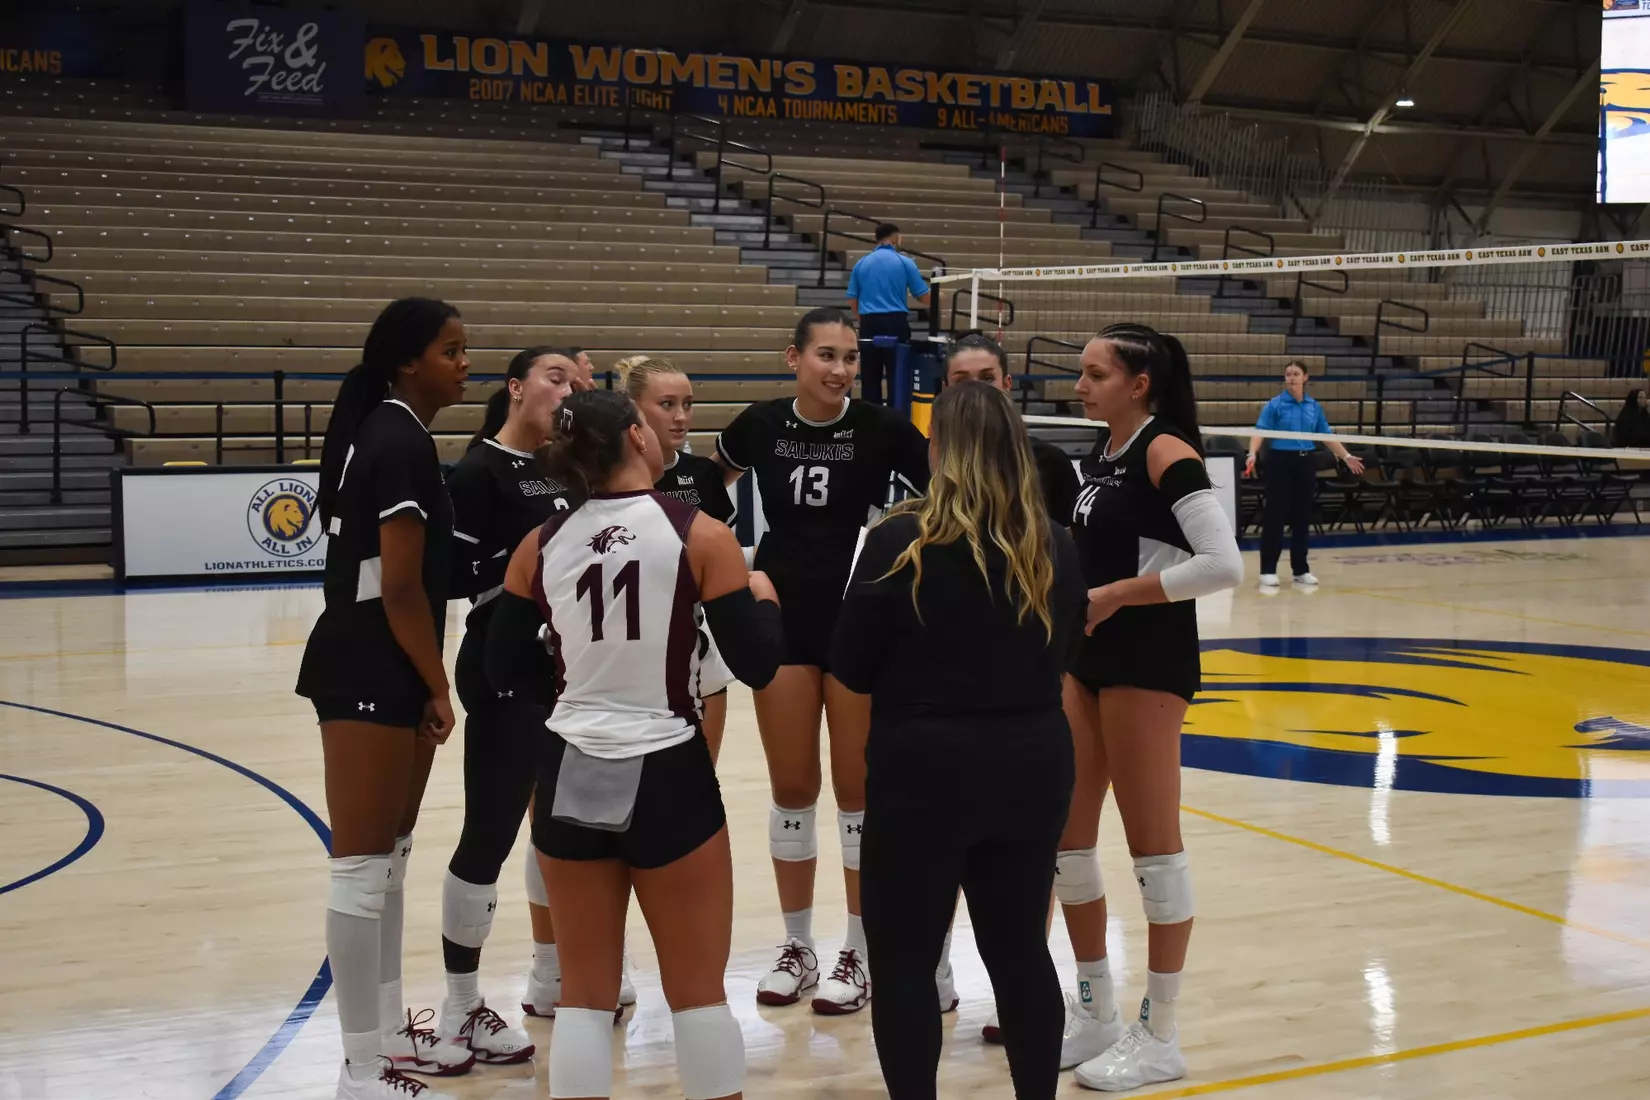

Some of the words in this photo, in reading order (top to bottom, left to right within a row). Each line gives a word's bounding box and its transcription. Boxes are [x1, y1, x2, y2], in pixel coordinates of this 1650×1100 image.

[226, 18, 284, 60] Fix
[284, 21, 319, 69] &
[0, 48, 62, 75] ICANS
[419, 34, 548, 77] LION
[568, 44, 816, 96] WOMEN'S
[833, 64, 1112, 115] BASKETBALL
[242, 55, 326, 97] Feed
[520, 81, 567, 105] NCAA
[573, 84, 620, 107] ELITE
[717, 95, 728, 115] 4
[733, 95, 777, 118] NCAA
[781, 98, 898, 125] TOURNAMENTS
[937, 107, 948, 128] 9
[1427, 254, 1445, 262] TEXAS
[1496, 250, 1516, 259] TEXAS
[1551, 248, 1569, 256] EAST
[1571, 246, 1593, 255] TEXAS
[1630, 244, 1650, 252] EAST
[774, 438, 854, 461] SALUKIS
[252, 488, 275, 513] ALL
[279, 481, 315, 508] LION
[788, 464, 830, 507] 13
[1072, 484, 1101, 527] 14
[261, 536, 290, 554] ALL
[295, 536, 313, 552] IN
[204, 558, 325, 571] LIONATHLETICS.CO
[576, 560, 641, 642] 11
